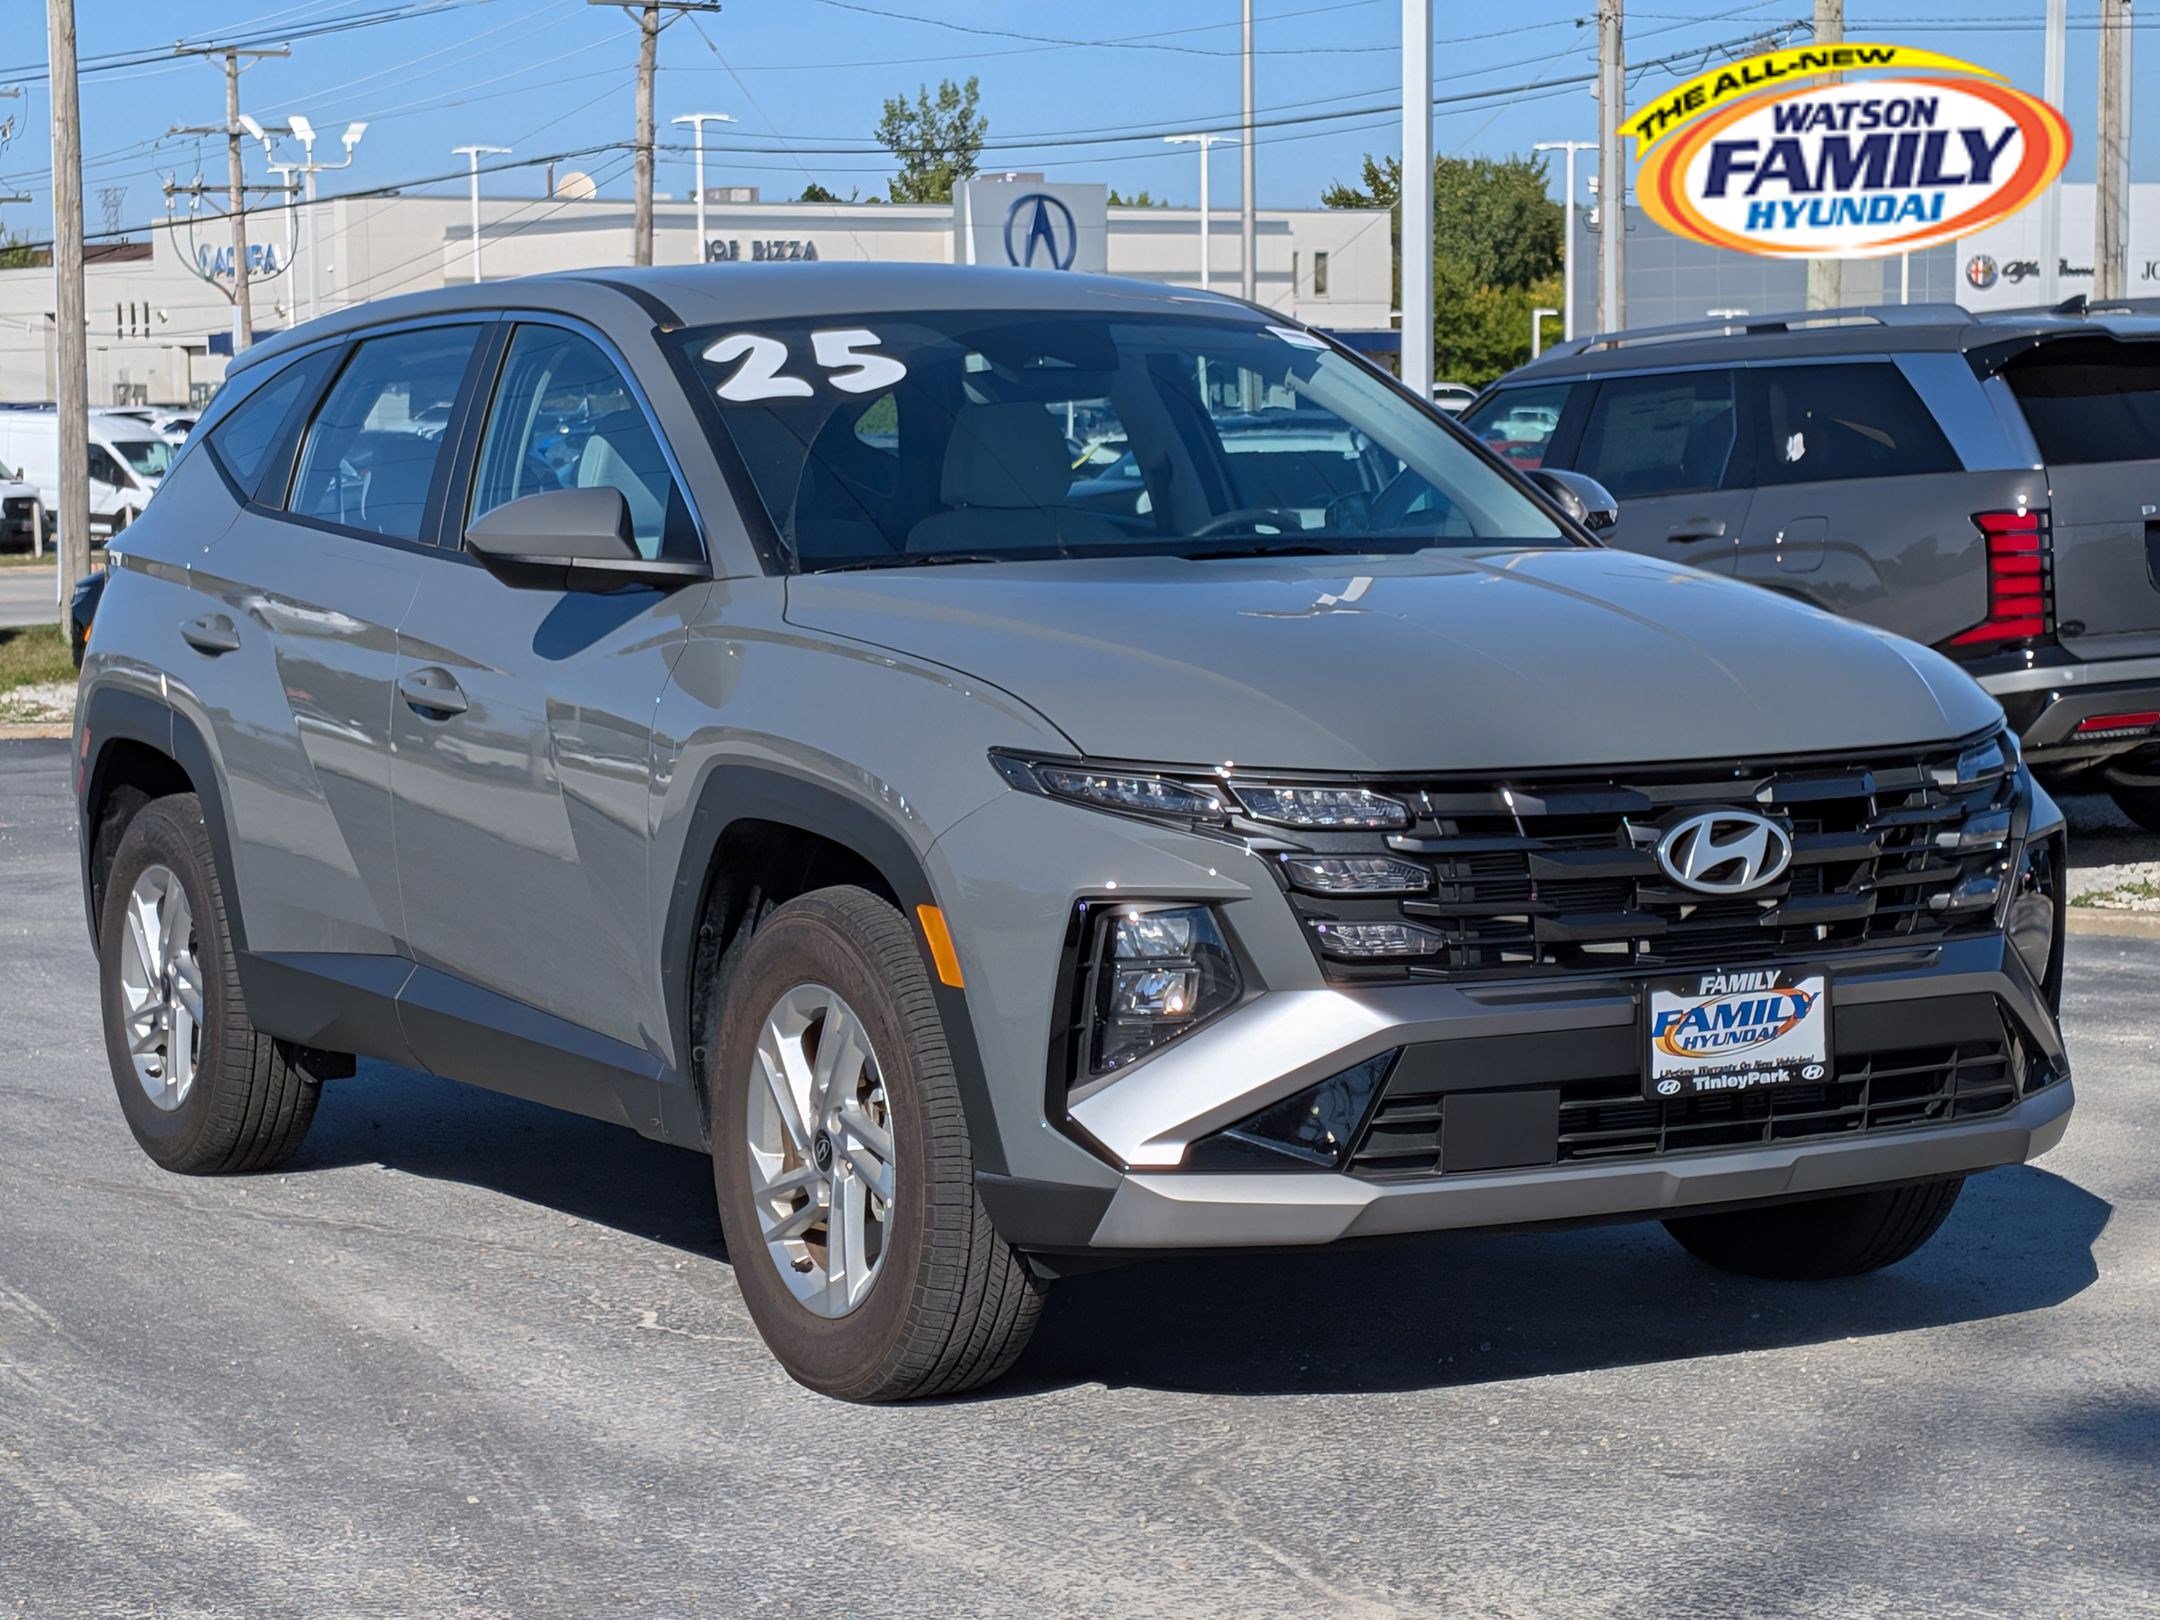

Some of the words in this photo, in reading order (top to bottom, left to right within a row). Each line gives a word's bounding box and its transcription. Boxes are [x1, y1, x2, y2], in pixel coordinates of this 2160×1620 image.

[702, 329, 907, 402] 25
[1700, 970, 1781, 995] FAMILY
[1652, 992, 1821, 1038] FAMILY
[1682, 1025, 1780, 1050] HYUNDAI
